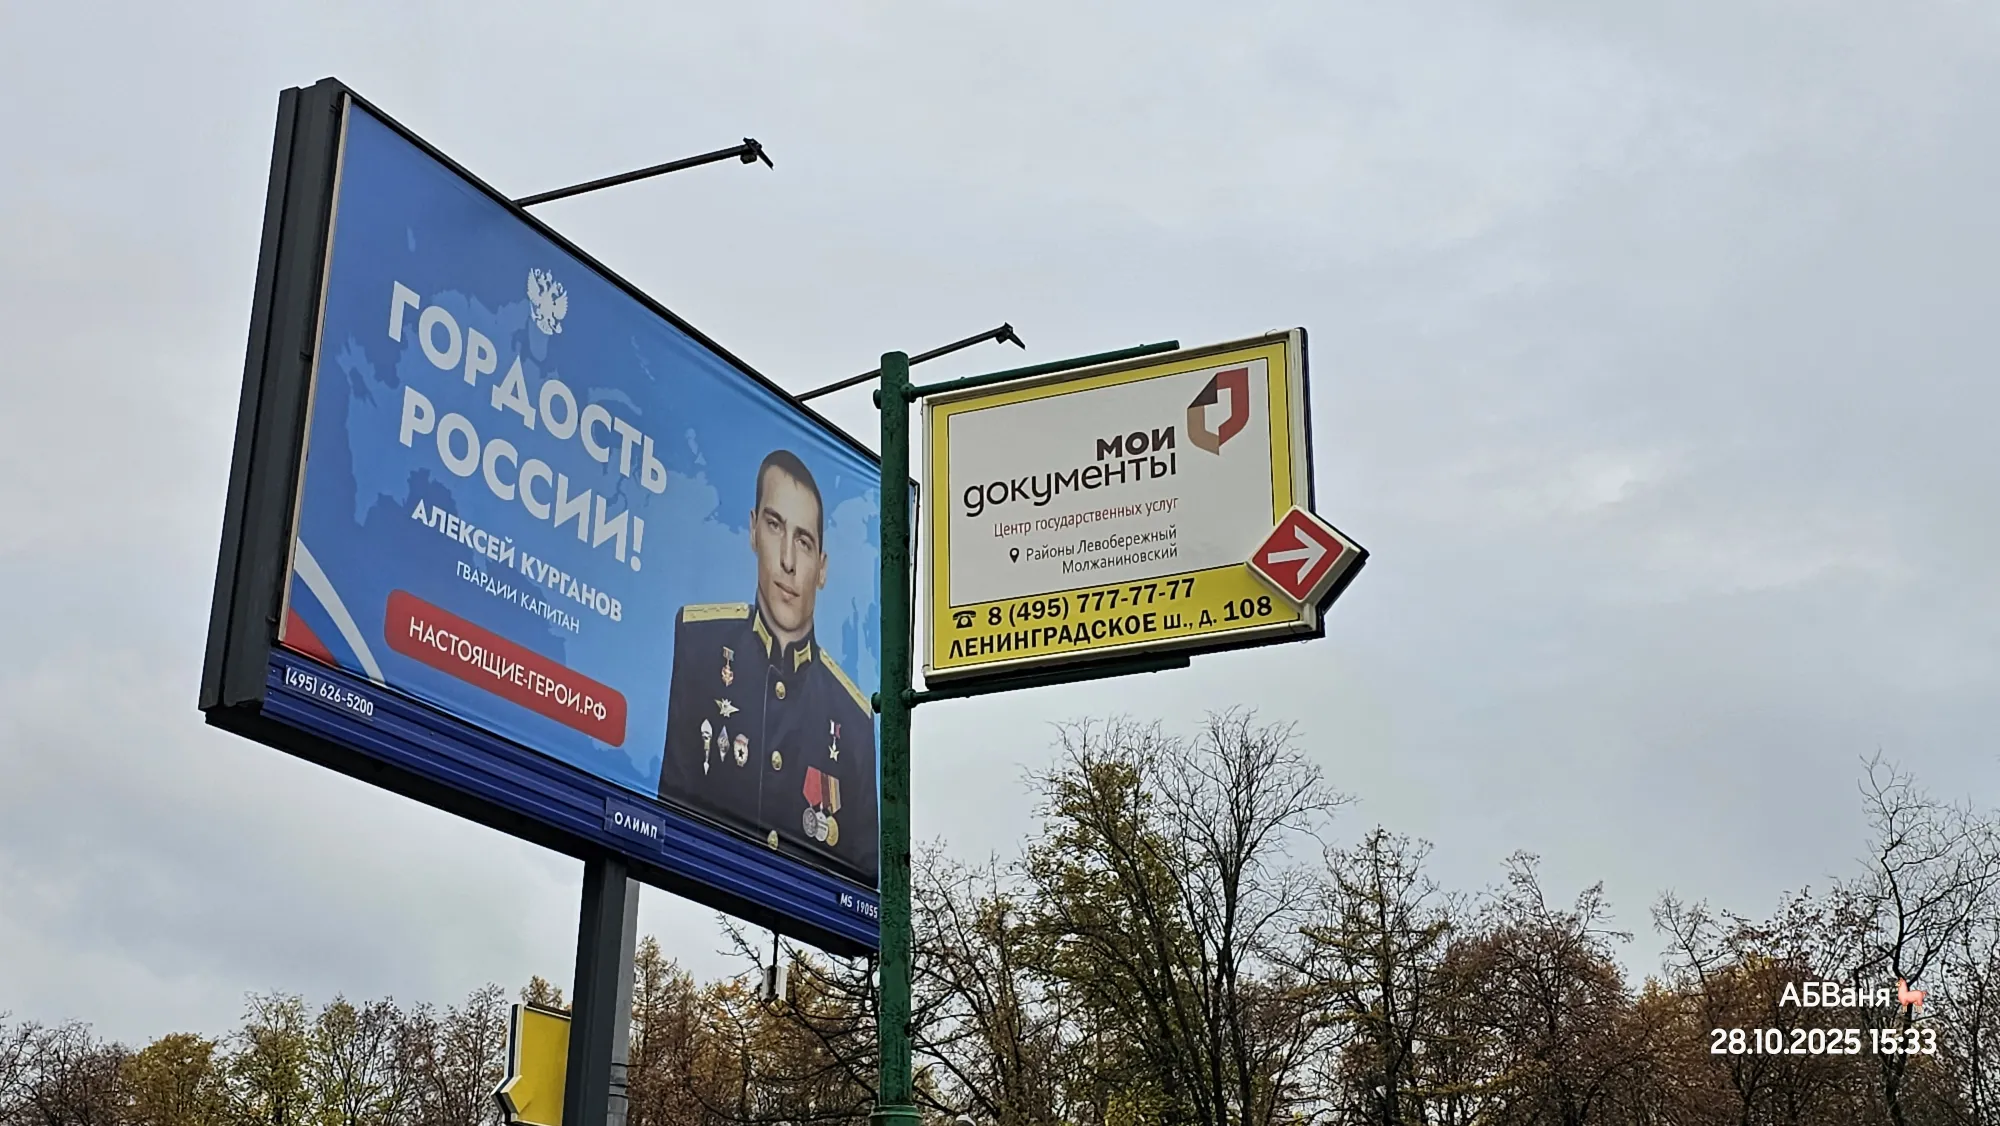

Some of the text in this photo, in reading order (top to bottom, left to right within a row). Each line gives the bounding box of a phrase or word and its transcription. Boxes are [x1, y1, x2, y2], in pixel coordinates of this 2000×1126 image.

[388, 280, 667, 494] ГОРДОСТЬ
[1096, 425, 1175, 461] мои
[399, 386, 645, 572] РОССИИ!
[963, 452, 1176, 518] документы
[994, 497, 1179, 538] Центр государственных услуг
[1026, 524, 1177, 562] Районы Левобережный
[411, 499, 623, 623] АЛЕКСЕЙ КУРГАНОВ
[1062, 543, 1178, 575] Молжаниновский
[456, 560, 580, 634] ГВАРДИИ КАПИТАН
[987, 577, 1196, 628] 8 (495) 777-77-77
[949, 612, 1157, 660] ЛЕНИНГРАДСКОЕ
[1223, 595, 1273, 622] 108
[285, 667, 374, 716] (495) 626-5200
[409, 616, 607, 722] НАСТОЯЩИЕ-ГЕРОИ.РФ
[614, 811, 658, 840] ОЛИМП
[840, 892, 853, 908] MS
